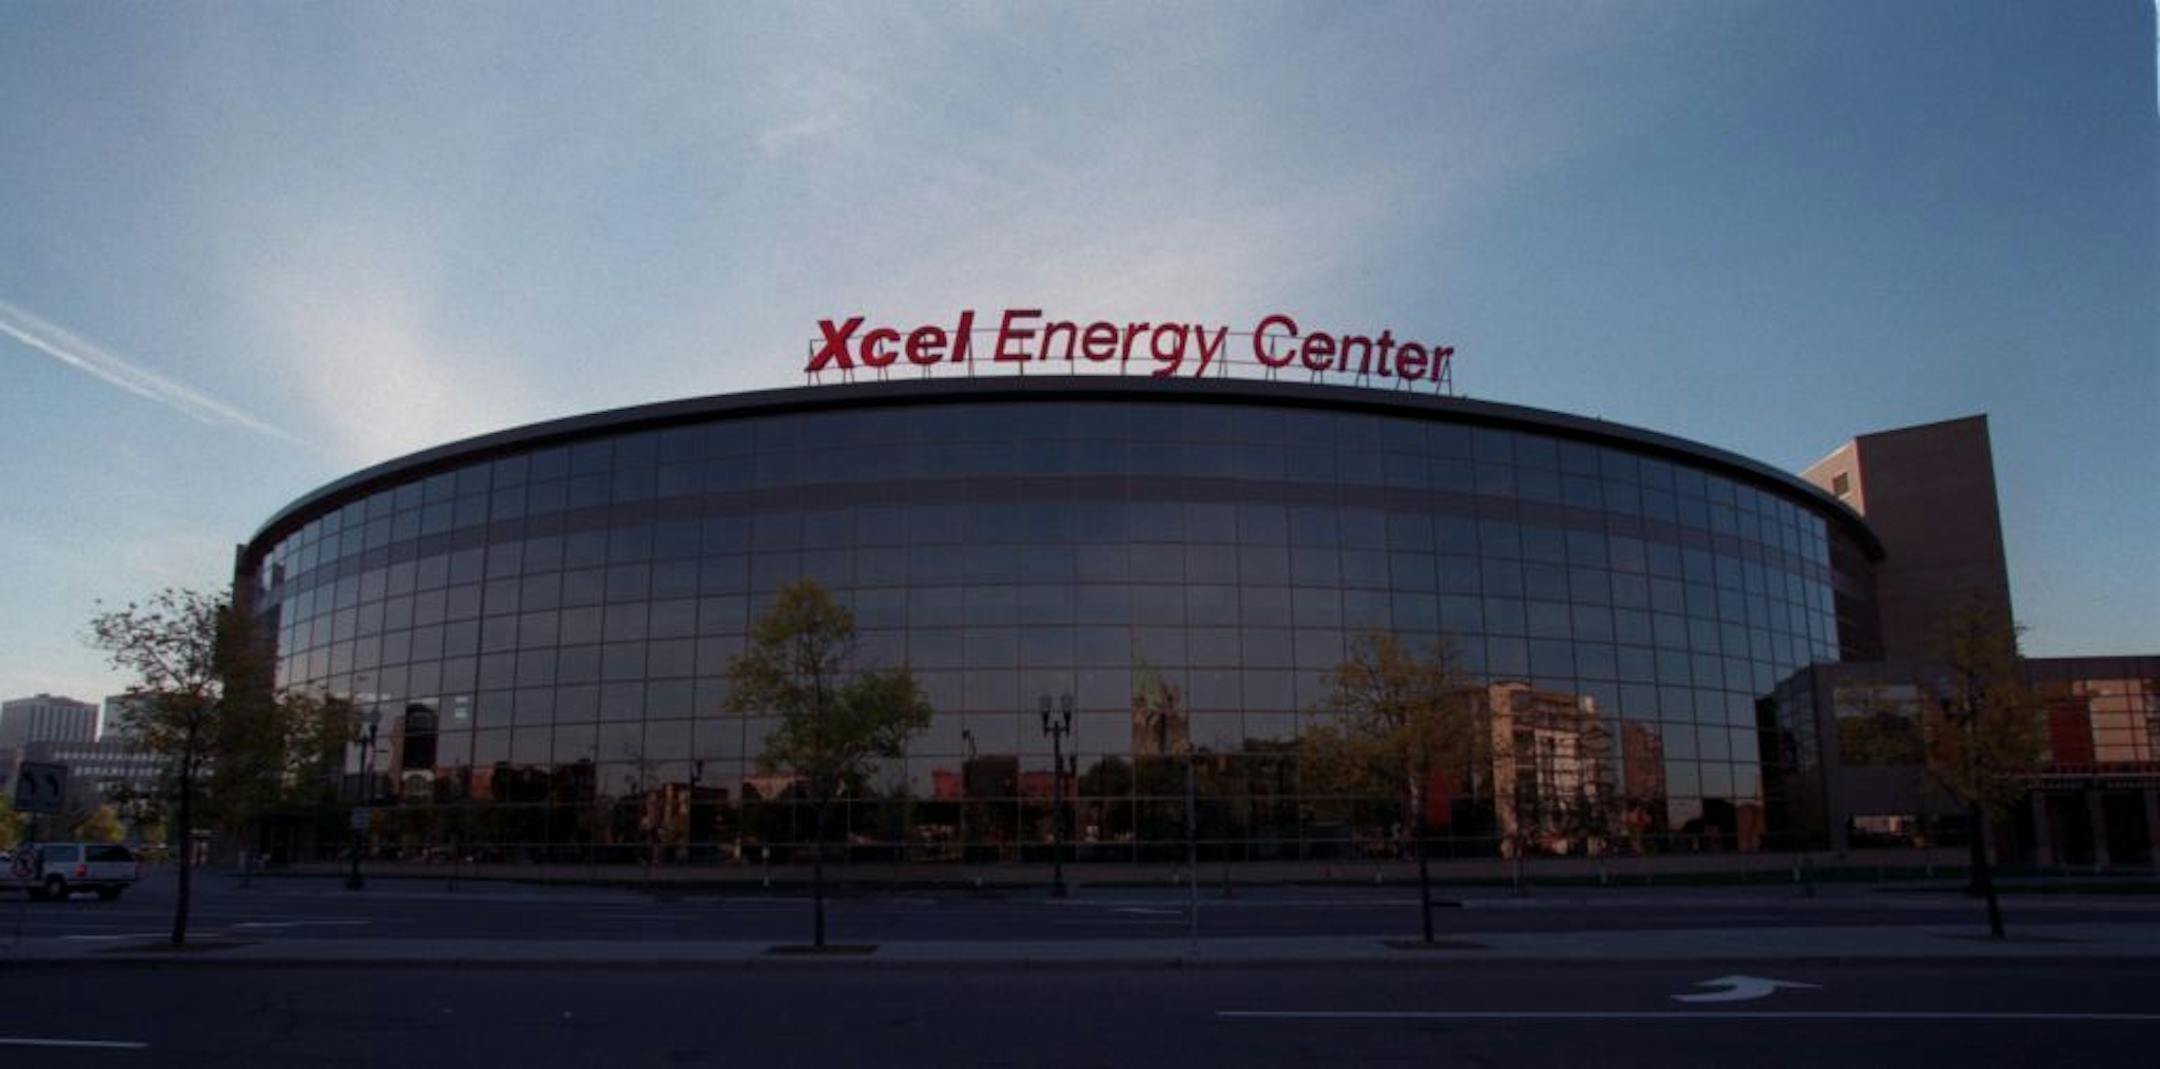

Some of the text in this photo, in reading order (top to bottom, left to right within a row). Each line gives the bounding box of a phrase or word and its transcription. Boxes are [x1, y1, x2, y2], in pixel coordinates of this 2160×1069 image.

[804, 308, 1454, 382] Xcel Energy Center
